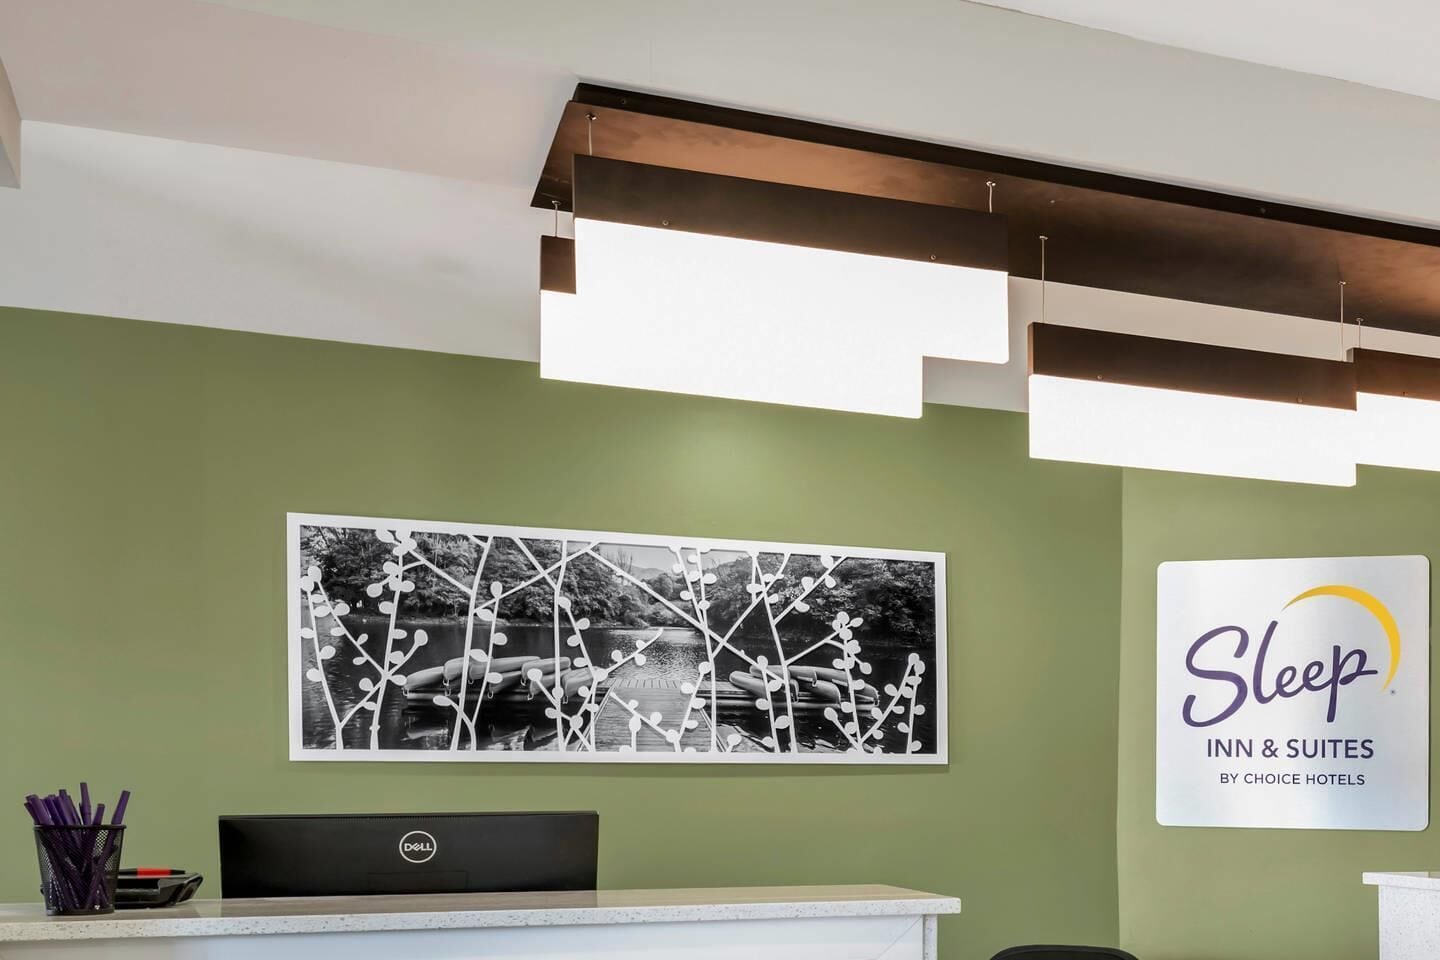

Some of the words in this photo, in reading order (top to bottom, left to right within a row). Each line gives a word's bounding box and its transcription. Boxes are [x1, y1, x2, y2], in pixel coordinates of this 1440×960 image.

[1182, 620, 1378, 728] Sleep
[1207, 739, 1253, 758] INN
[1262, 739, 1279, 758] &
[1286, 739, 1374, 759] SUITES
[1220, 773, 1239, 784] BY
[1244, 773, 1301, 785] CHOICE
[1306, 774, 1365, 785] HOTELS
[404, 842, 432, 851] DELL
